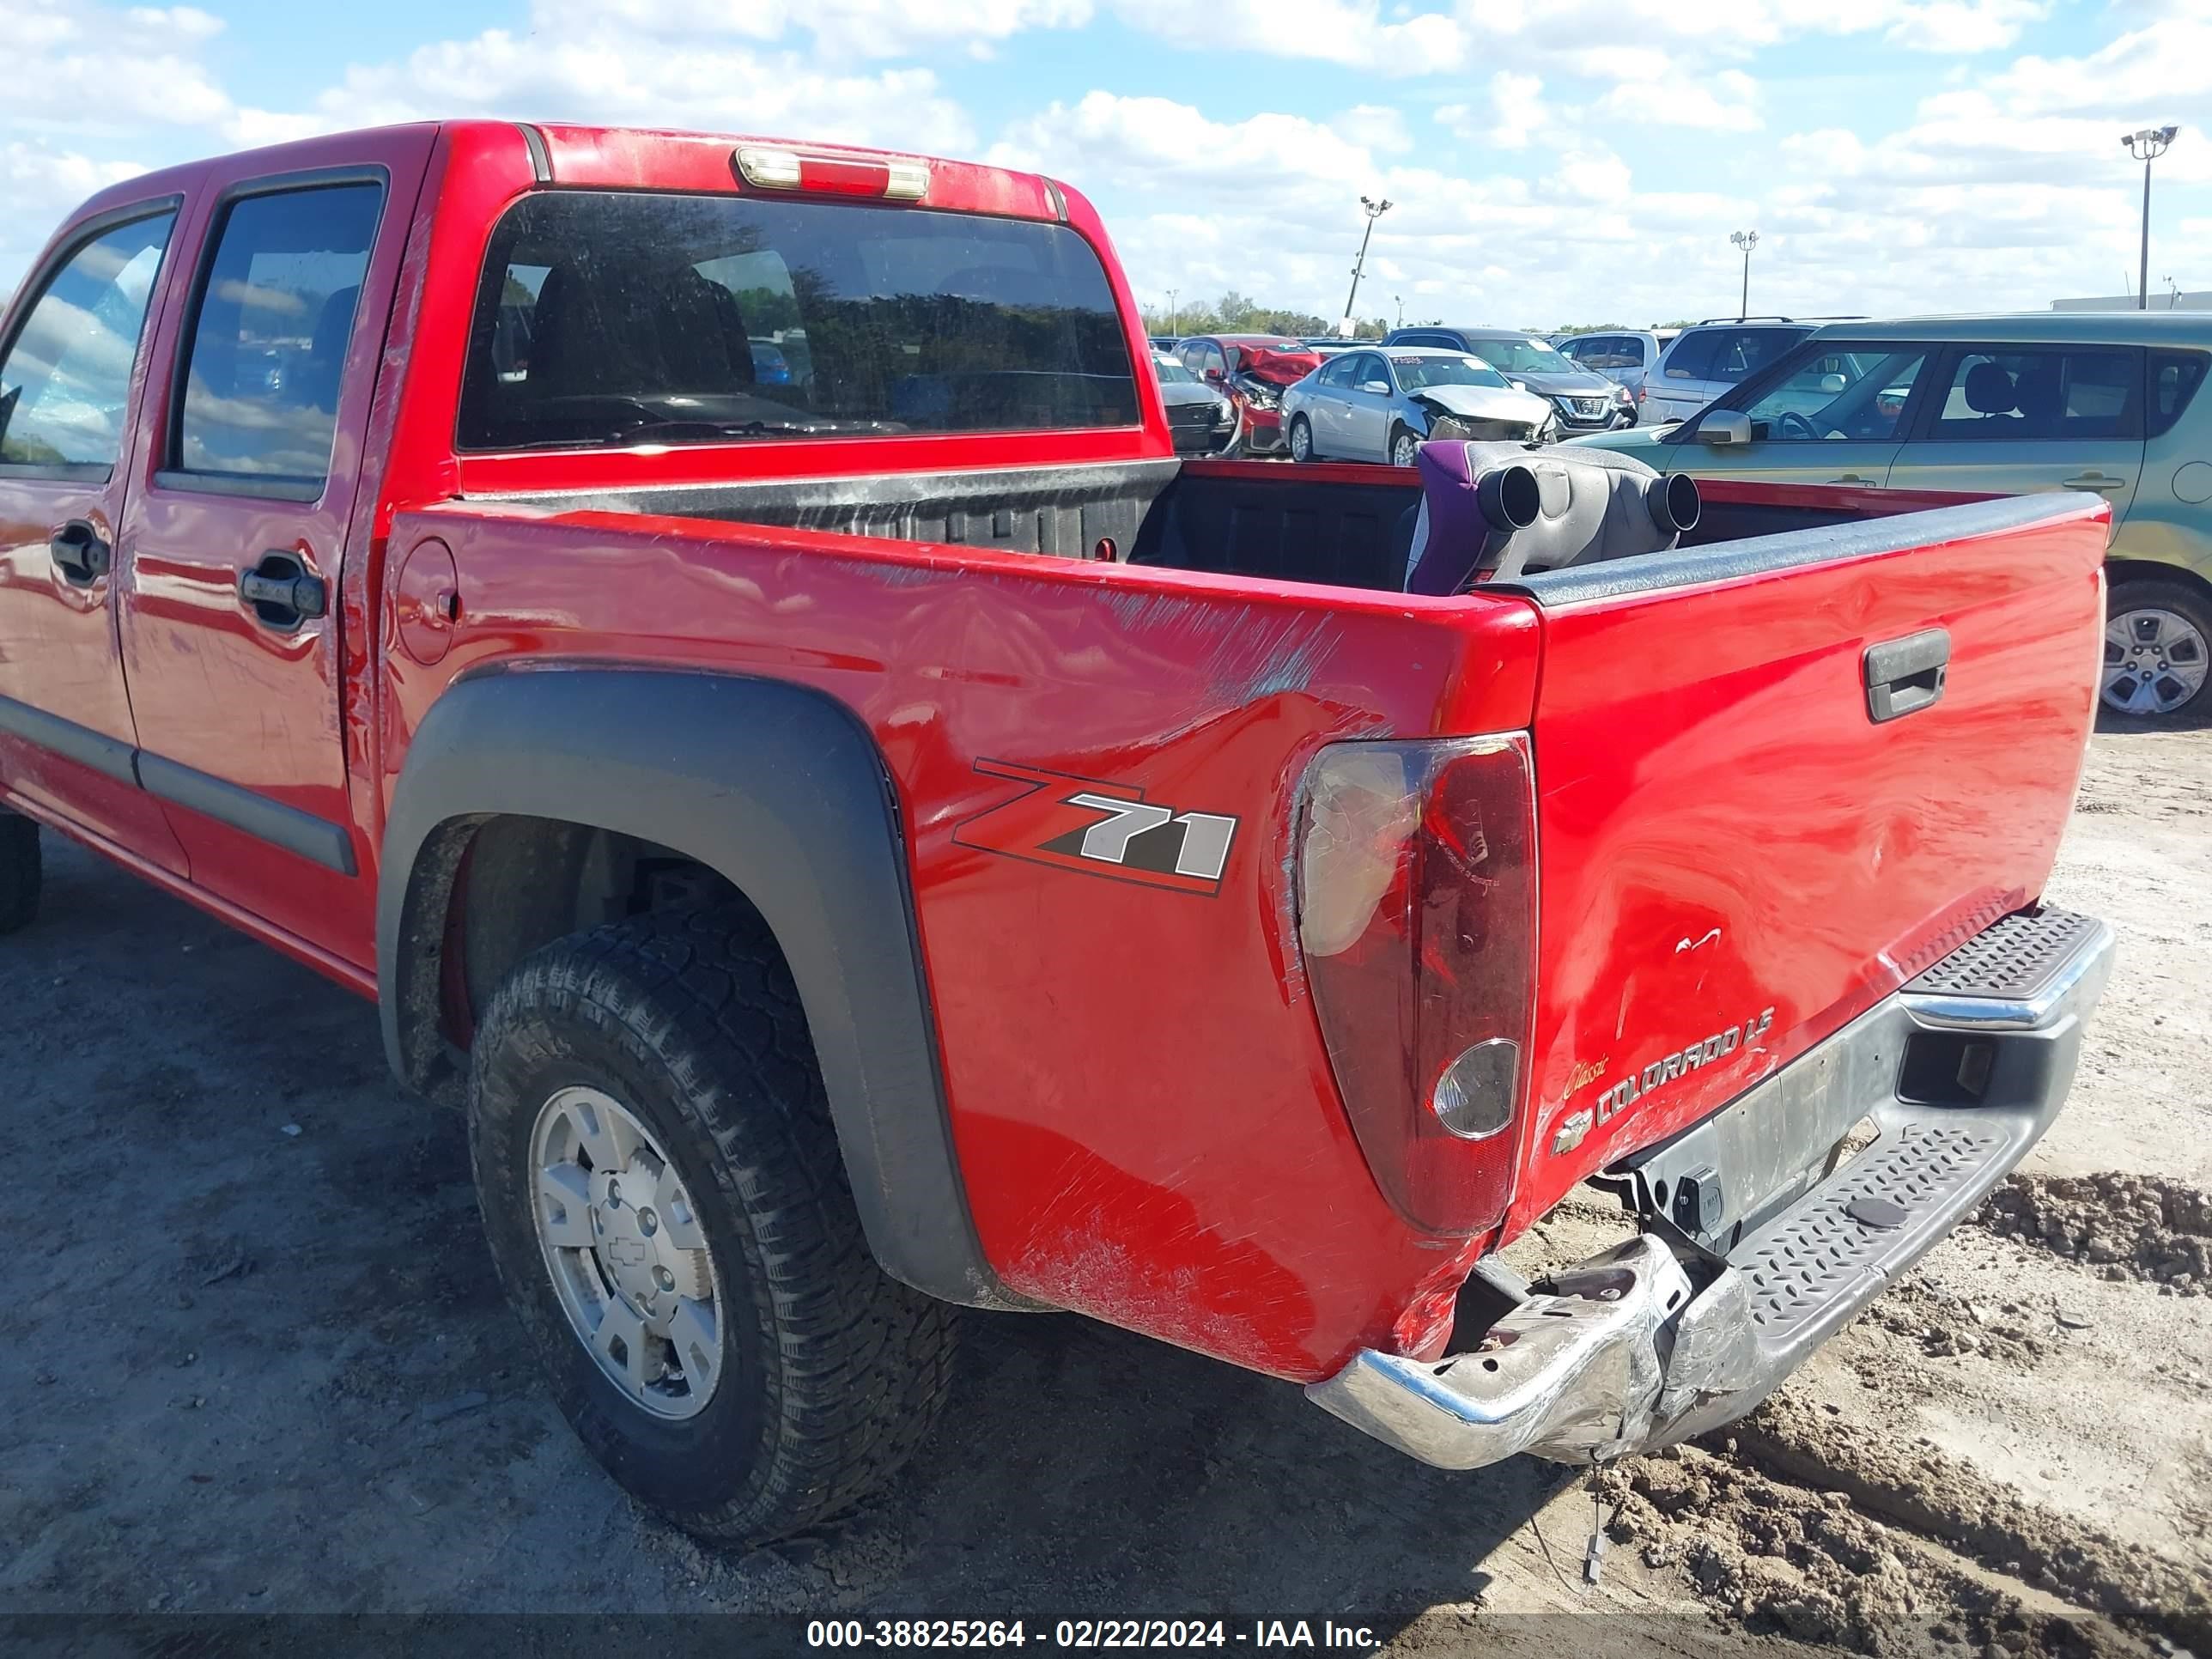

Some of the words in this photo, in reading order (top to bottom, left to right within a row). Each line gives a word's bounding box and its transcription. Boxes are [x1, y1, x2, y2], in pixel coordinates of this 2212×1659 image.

[1563, 1053, 1609, 1100] Classic
[1595, 1024, 1741, 1127] COLORADO
[1742, 1006, 1775, 1045] LS
